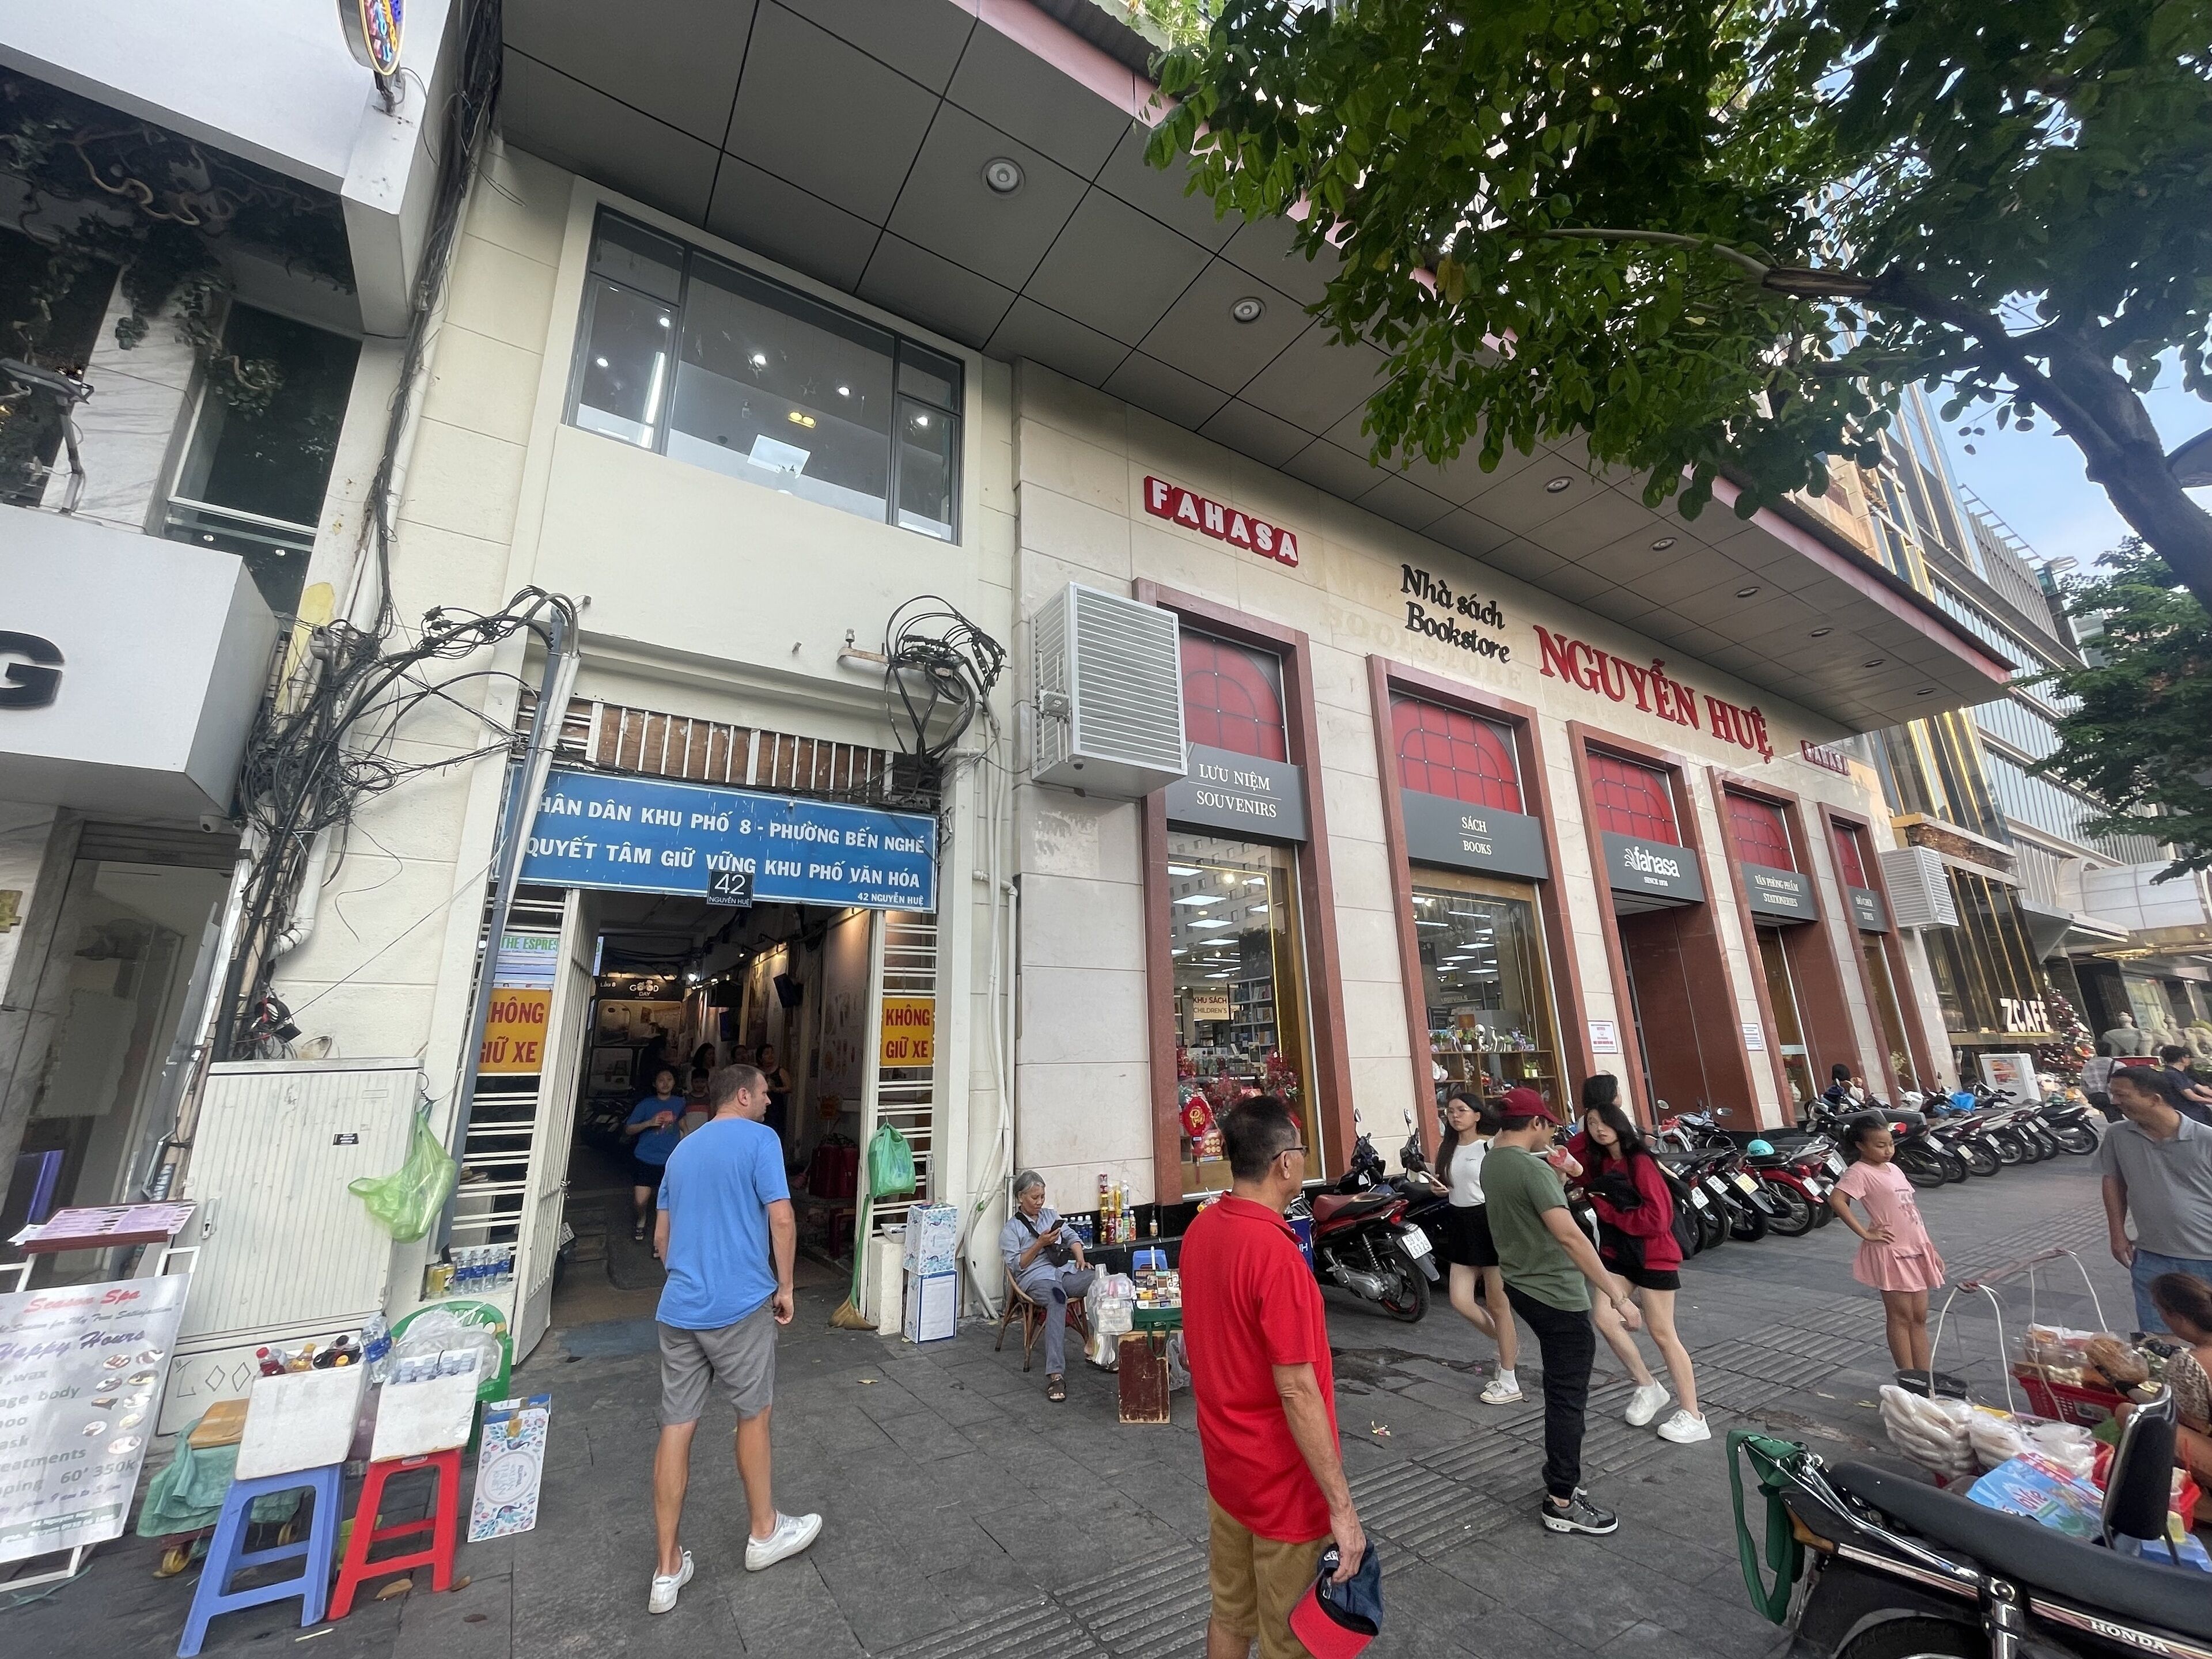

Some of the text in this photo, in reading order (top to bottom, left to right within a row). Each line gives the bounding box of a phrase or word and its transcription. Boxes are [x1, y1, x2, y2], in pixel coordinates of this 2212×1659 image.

[1152, 479, 1298, 562] FAHASA
[1400, 563, 1505, 630] Nhà sách
[1404, 601, 1511, 664] Bookstore
[1533, 624, 1774, 764] NGUYỄN HUỆ
[1198, 763, 1271, 791] LƯU NIỆM
[1196, 790, 1277, 818] SOUVENIRS
[537, 793, 581, 816] HÂN
[588, 799, 631, 821] DÂN
[641, 808, 682, 827] KHU
[691, 810, 733, 832] PHỐ
[739, 819, 752, 835] 8
[770, 821, 839, 844] PHƯỜNG
[846, 827, 878, 849] BẾN
[884, 835, 925, 854] NGHÉ
[1461, 815, 1487, 833] SÁCH
[1463, 840, 1492, 855] BOOKS
[525, 835, 919, 888] QUYẾT TÂM GIỮ VỮNG KHU PHỐ VĂN HÓA
[1633, 846, 1680, 878] fahasa
[714, 873, 745, 895] 42
[709, 896, 737, 905] NGUYỄN
[857, 891, 924, 907] 42 NGUYỄN HUỆ
[501, 937, 519, 949] THE
[486, 997, 544, 1023] HÔNG
[1209, 996, 1227, 1004] SÁCH
[885, 1003, 930, 1026] KHÔNG
[512, 1041, 538, 1063] XE
[886, 1036, 928, 1058] GIỮ XE
[100, 1289, 141, 1305] Spa
[79, 1330, 145, 1349] Hours
[38, 1385, 80, 1401] body
[2090, 1620, 2170, 1653] HONDA
